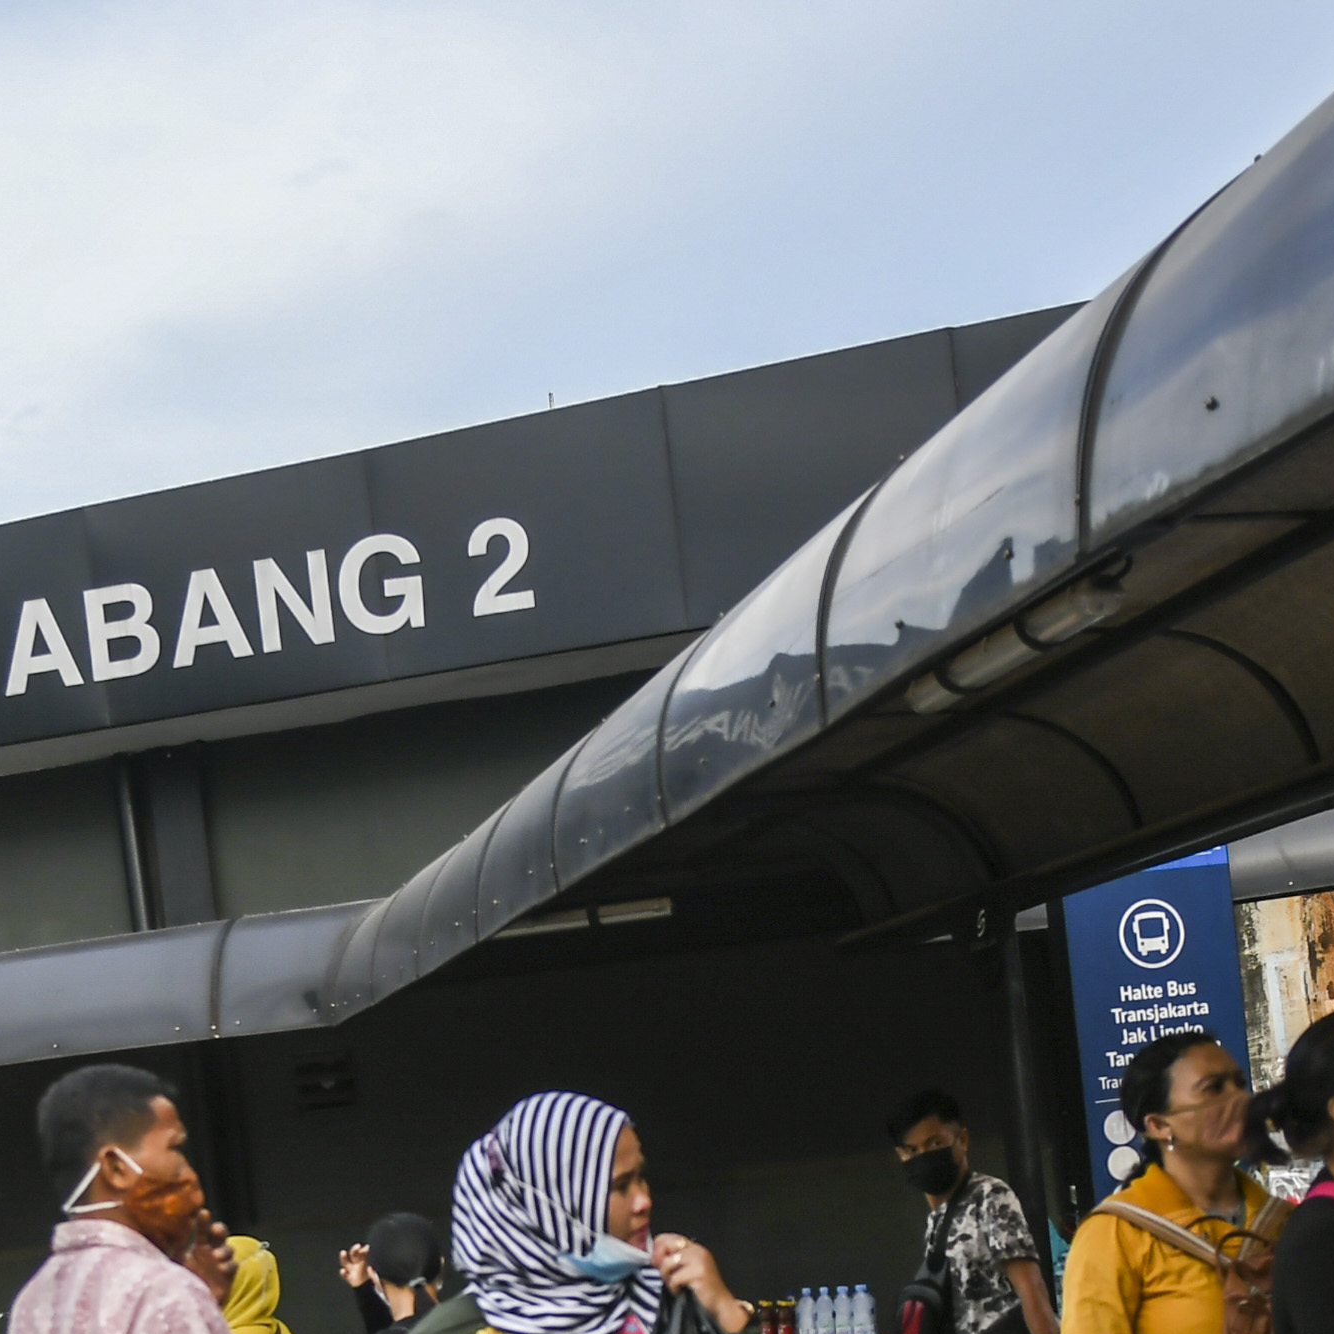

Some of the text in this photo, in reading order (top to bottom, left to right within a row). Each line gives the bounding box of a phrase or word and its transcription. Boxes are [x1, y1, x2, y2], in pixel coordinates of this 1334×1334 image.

[5, 532, 426, 697] ABANG
[467, 517, 536, 617] 2
[1119, 980, 1197, 1002] Halte Bus
[1110, 1001, 1210, 1024] Transjakarta
[1121, 1026, 1148, 1046] Jak
